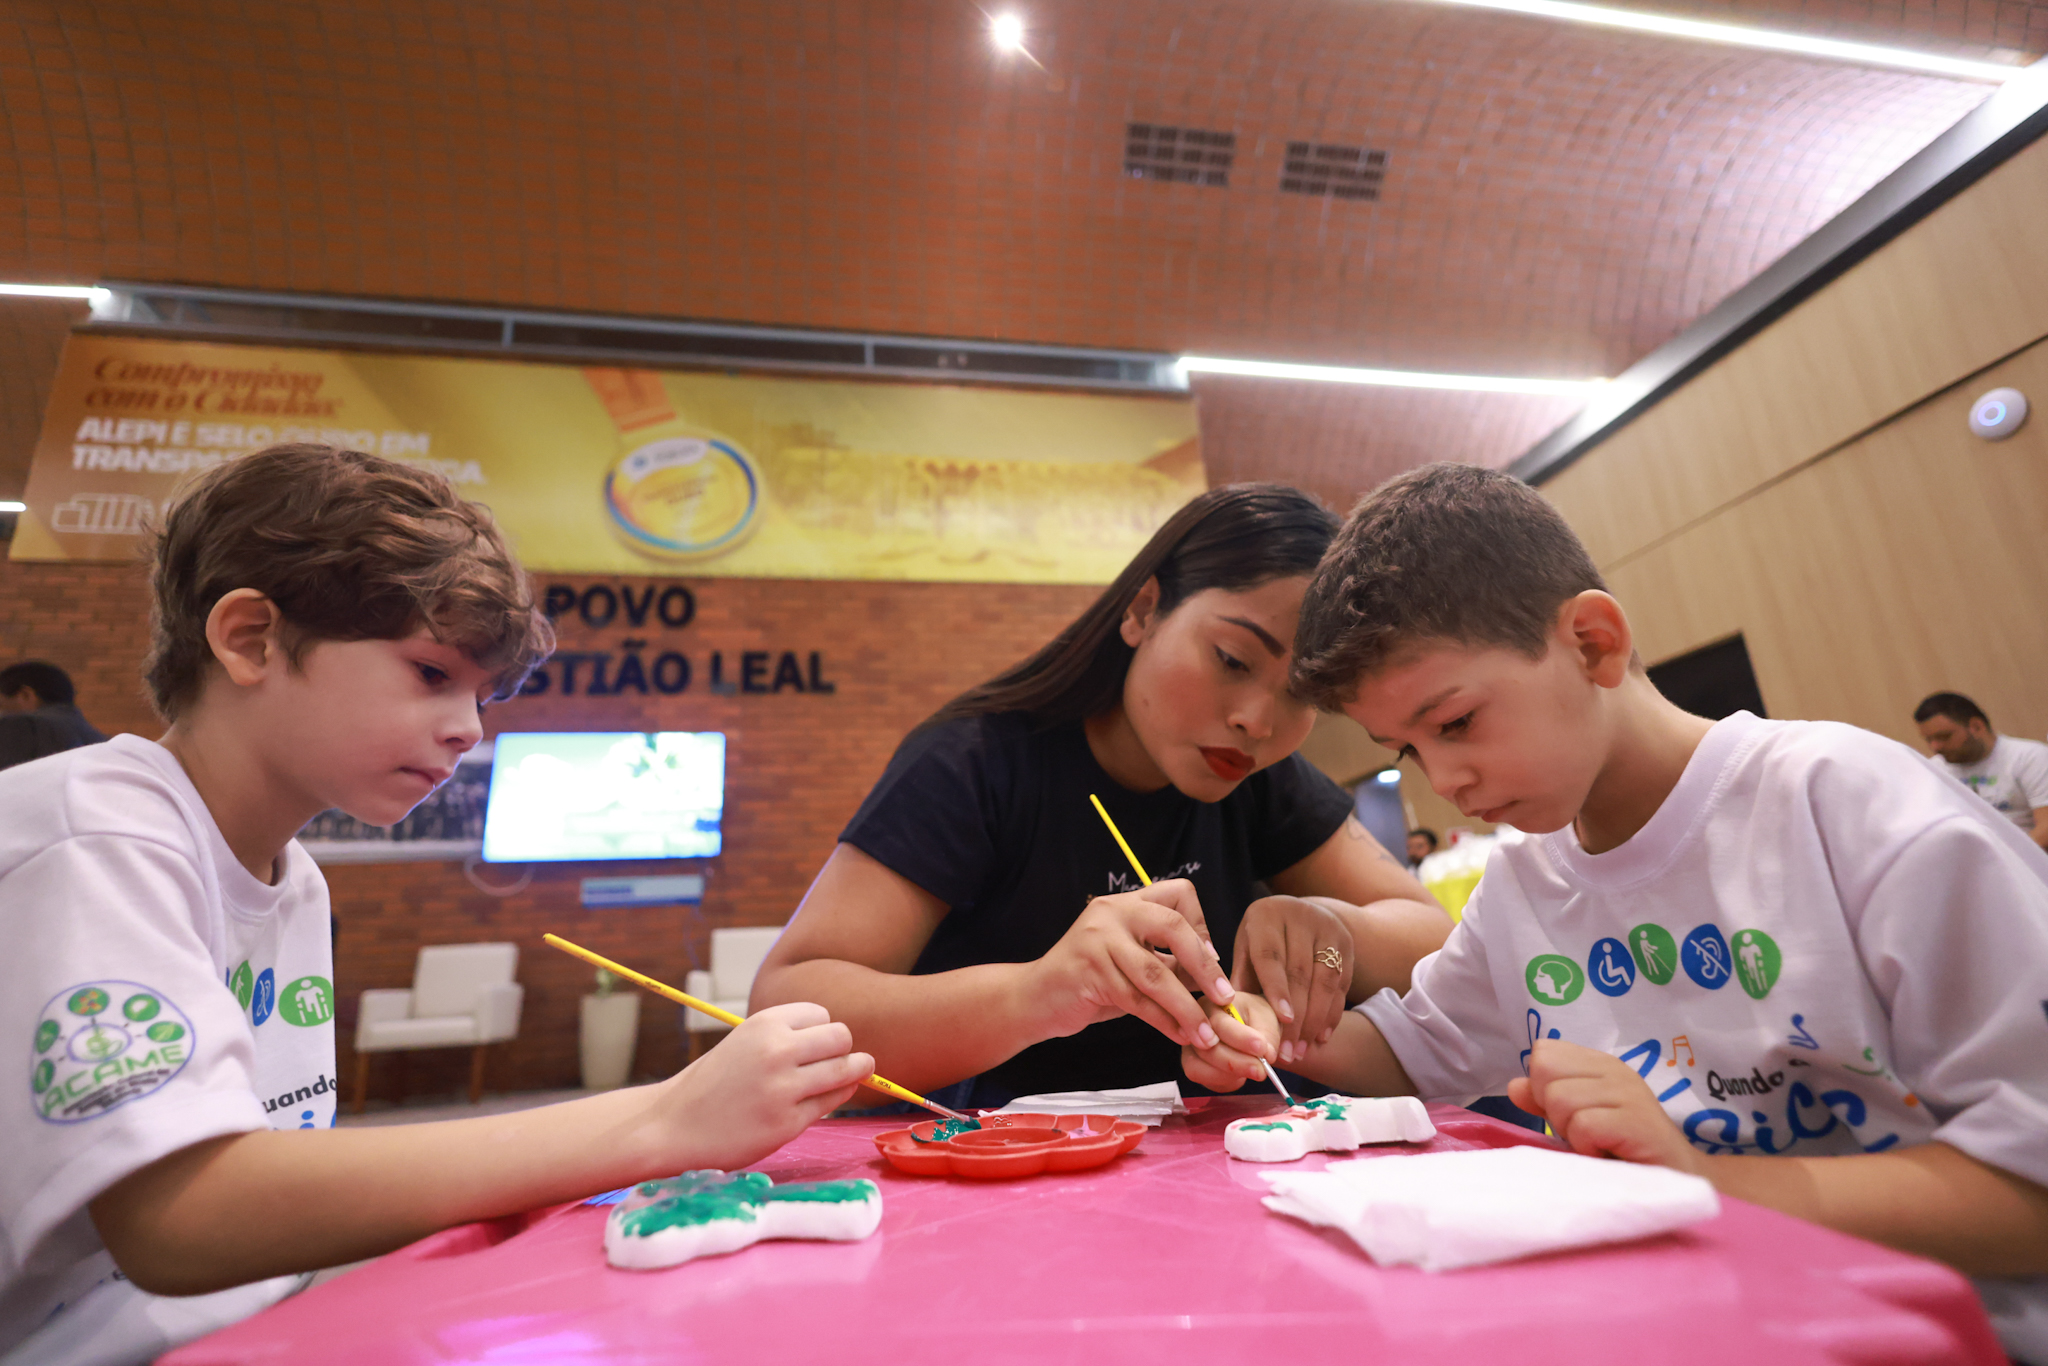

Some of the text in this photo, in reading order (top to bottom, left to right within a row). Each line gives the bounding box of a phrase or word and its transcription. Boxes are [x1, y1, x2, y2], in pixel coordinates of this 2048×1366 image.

[544, 584, 697, 629] POVO
[709, 650, 836, 697] LEAL
[262, 1073, 337, 1114] uando
[1706, 1067, 1785, 1102] Quando
